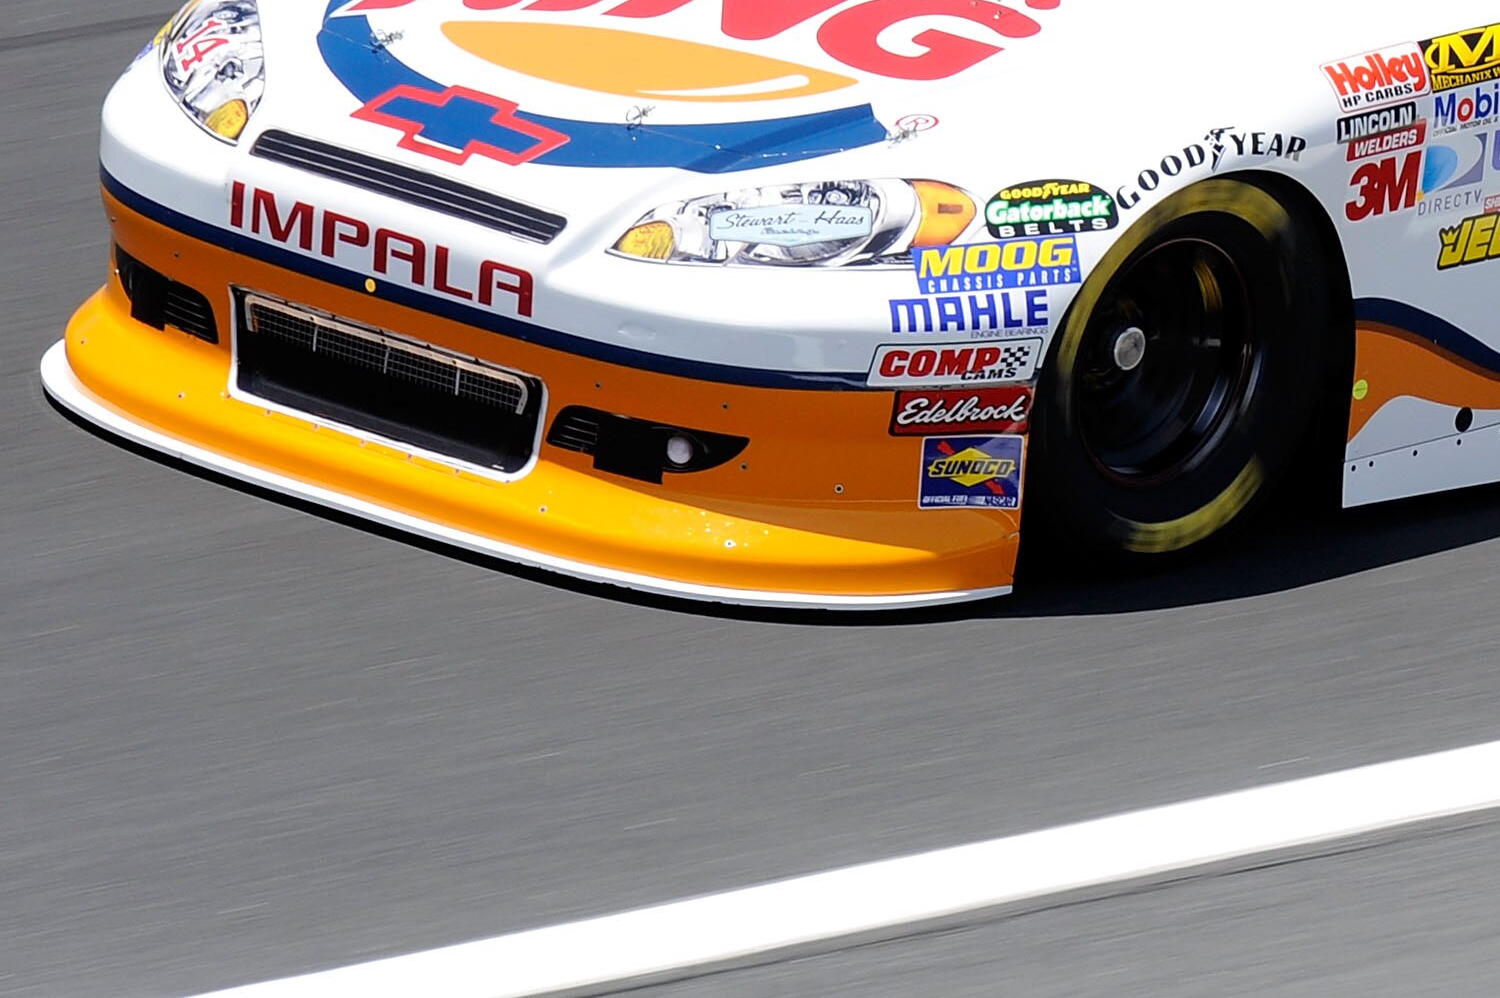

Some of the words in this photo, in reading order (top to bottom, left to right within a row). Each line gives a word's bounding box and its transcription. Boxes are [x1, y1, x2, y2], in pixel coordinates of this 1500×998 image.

[176, 20, 229, 72] 14
[1324, 51, 1426, 96] Holley
[1431, 69, 1493, 92] MECHANIX
[1341, 95, 1362, 109] HP
[1365, 82, 1415, 103] CARBS
[1340, 105, 1414, 138] LINCOLN
[1460, 119, 1481, 130] MOTOR
[1354, 130, 1418, 157] WELDERS
[1116, 127, 1306, 210] GOODYEAR
[1000, 182, 1091, 200] GOODYEAR
[1345, 151, 1422, 221] 3M
[986, 194, 1112, 225] Gatorback
[1418, 189, 1482, 216] DIRECTV
[717, 212, 795, 230] Stewart
[814, 209, 864, 225] Haas
[998, 218, 1109, 238] BELTS
[230, 180, 535, 318] IMPALA
[919, 238, 1073, 278] MOOG
[928, 274, 1004, 293] CHASSIS
[1017, 266, 1072, 286] PARTS
[889, 289, 1049, 333] MAHLE
[1005, 328, 1048, 337] BEARINGS
[879, 347, 1001, 377] COMP
[961, 367, 1017, 381] CAMS
[896, 395, 1027, 425] Edelbrock
[931, 460, 1012, 476] SUNOCO
